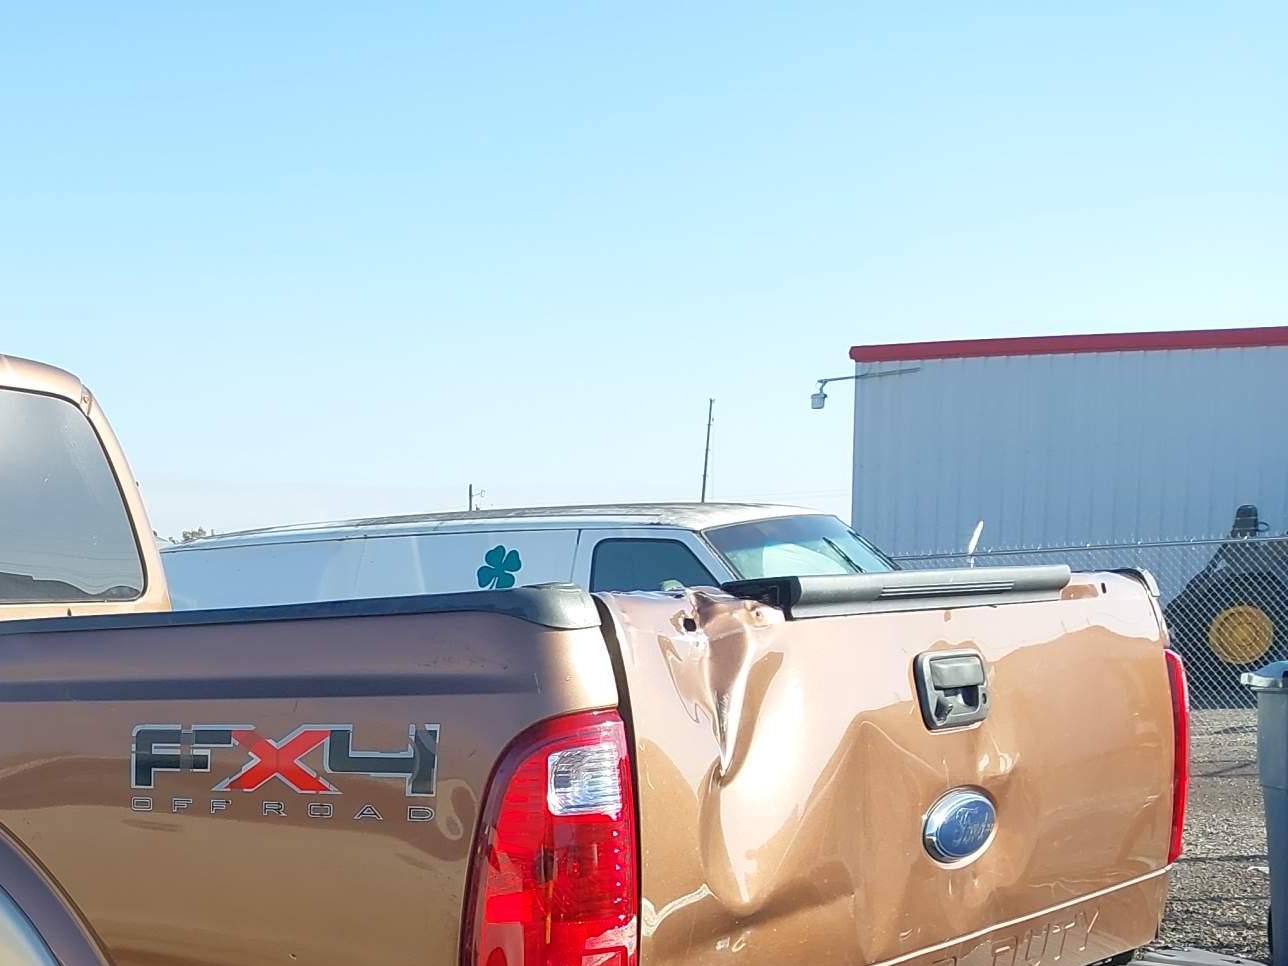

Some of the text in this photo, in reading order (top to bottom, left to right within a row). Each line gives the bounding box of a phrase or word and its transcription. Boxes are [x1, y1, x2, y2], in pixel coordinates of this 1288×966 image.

[131, 724, 440, 796] FX4
[131, 797, 436, 822] OFF ROAD
